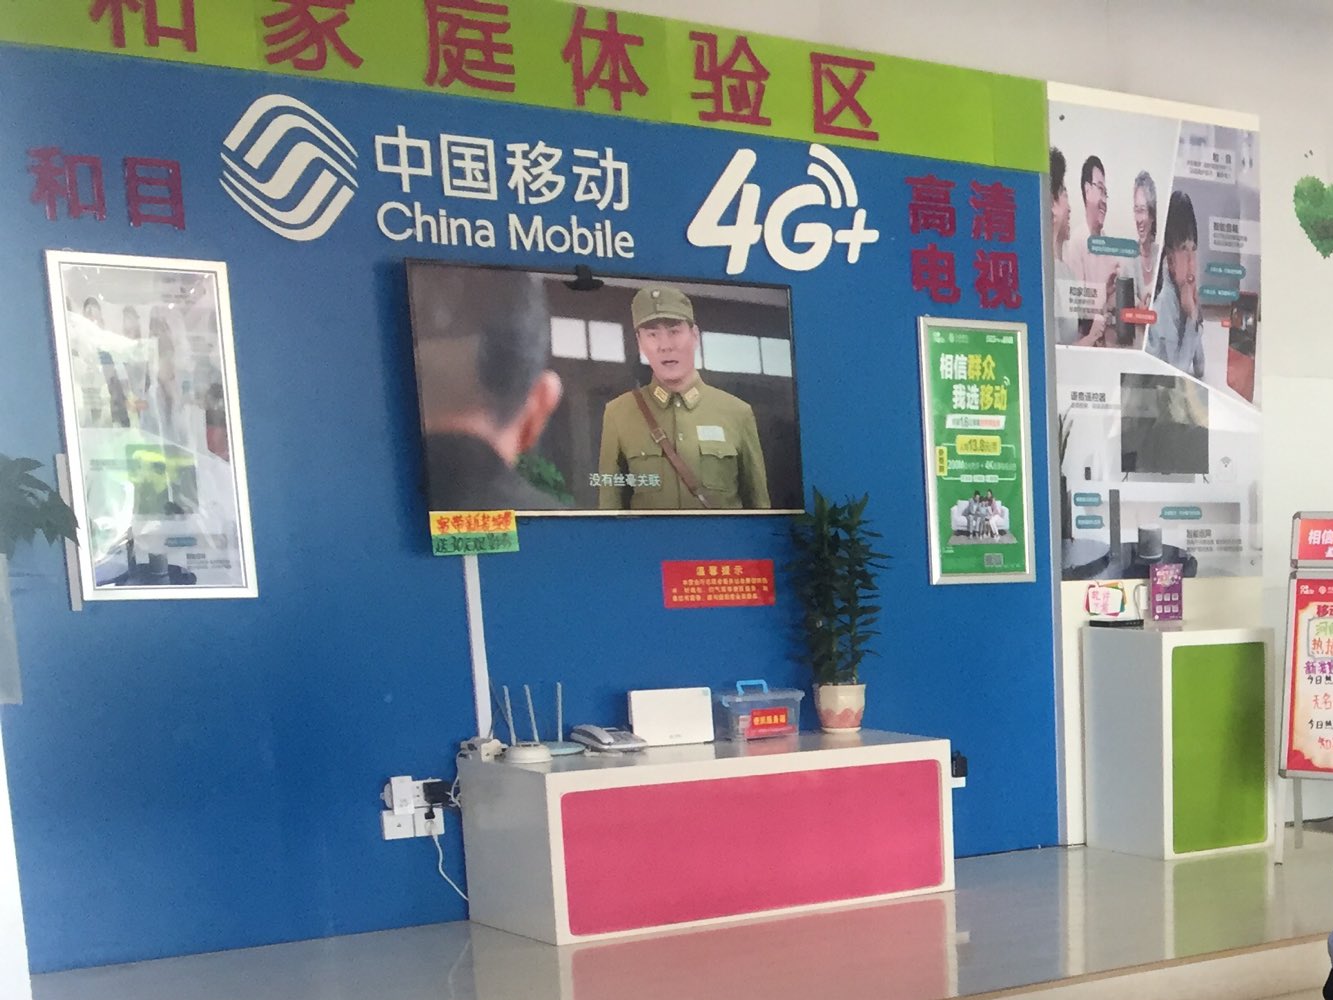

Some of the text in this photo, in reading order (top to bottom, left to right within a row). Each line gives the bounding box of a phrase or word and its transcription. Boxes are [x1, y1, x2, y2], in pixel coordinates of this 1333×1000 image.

[27, 145, 188, 232] 和目
[375, 125, 630, 212] 中国移动
[376, 202, 635, 260] China Mobile
[686, 147, 880, 275] 4G+
[905, 173, 1018, 243] 高清
[911, 242, 1022, 310] 电视
[939, 352, 997, 382] 相信群众
[952, 382, 1008, 411] 我选移动
[588, 472, 662, 488] 没有丝毫关联
